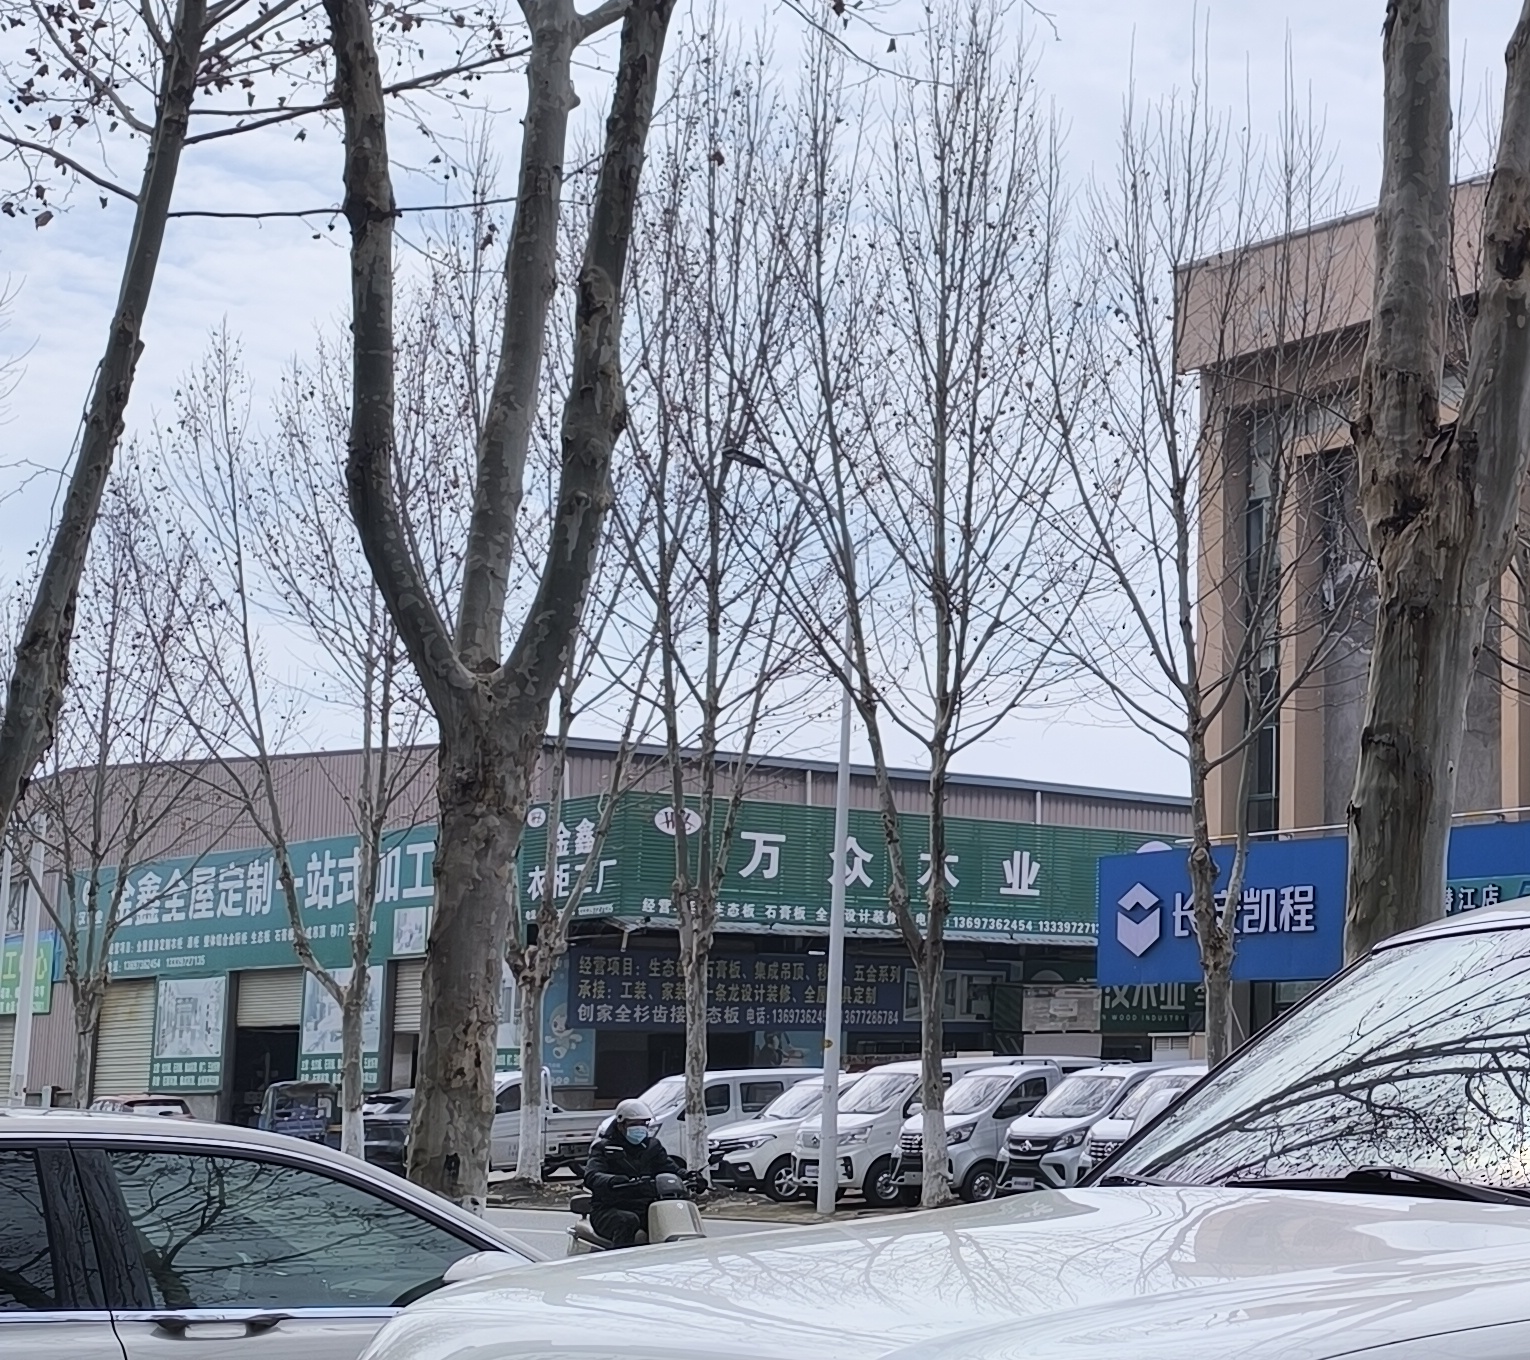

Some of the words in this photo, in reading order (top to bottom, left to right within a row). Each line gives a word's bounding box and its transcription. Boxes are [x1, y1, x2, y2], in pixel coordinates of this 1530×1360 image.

[815, 906, 897, 926] 全设计装修
[577, 1003, 740, 1025] 创家全杉齿接态板
[1112, 1014, 1138, 1022] WOOD
[1141, 1014, 1186, 1022] INDUSTRY
